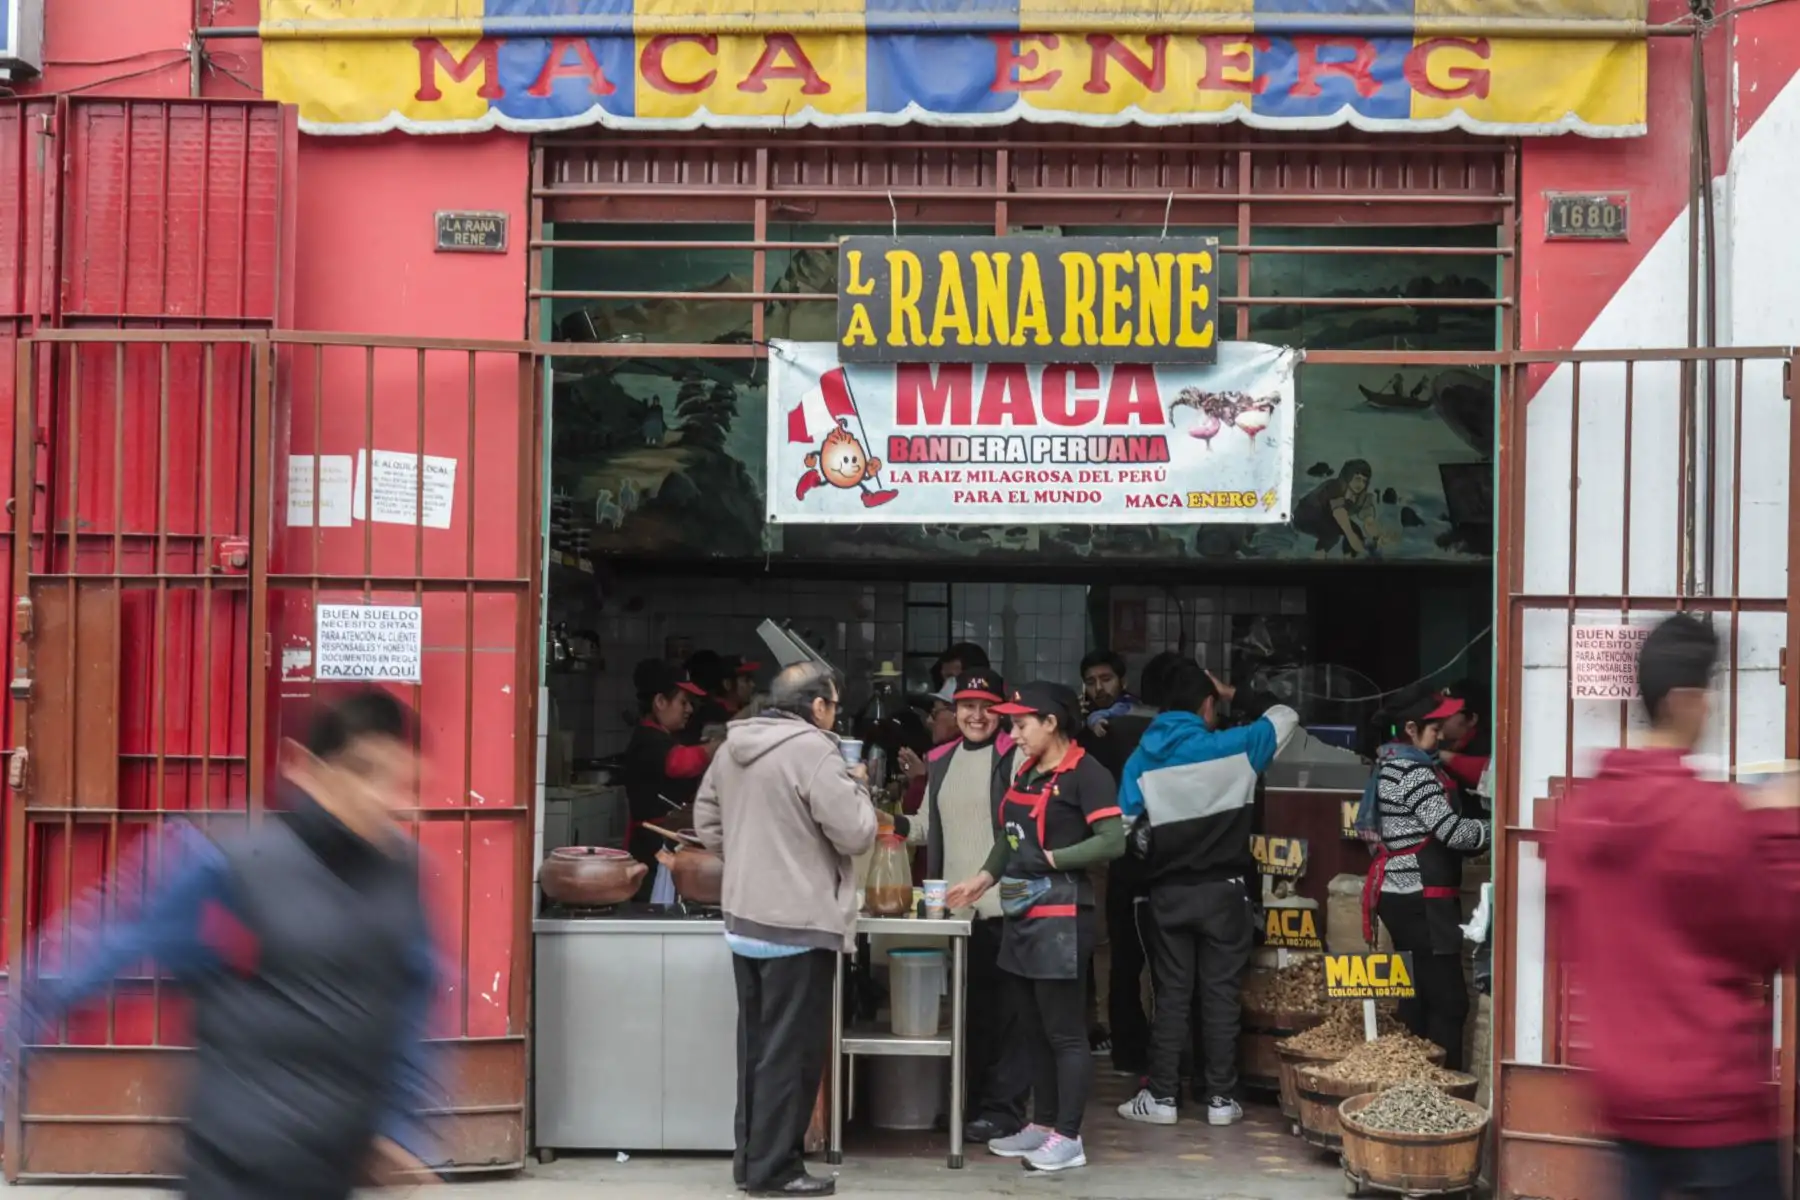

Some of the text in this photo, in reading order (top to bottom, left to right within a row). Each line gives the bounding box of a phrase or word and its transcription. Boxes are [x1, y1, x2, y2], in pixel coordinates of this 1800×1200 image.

[413, 32, 1491, 102] MACA ENERG
[1560, 205, 1616, 228] 1680
[446, 220, 496, 232] LA RANA
[455, 232, 486, 245] RENE
[885, 250, 1053, 346] RANA
[1059, 250, 1214, 347] RENE
[896, 363, 1166, 426] MACA
[888, 435, 1170, 463] BANDERA PERUANA
[424, 464, 448, 474] OCAL
[890, 466, 1167, 483] LA RAIZ MILAGROSA DEL PERÚ
[953, 490, 1102, 503] PARA EL MUNDO
[1125, 491, 1258, 508] MACA ENERG
[322, 609, 419, 620] BUEN SUELDO
[321, 620, 376, 629] NECESITO
[321, 631, 340, 641] PARA
[389, 632, 417, 642] CLIENTE
[1576, 629, 1650, 640] BUEN SUE
[322, 642, 375, 652] RESPONSABLES
[383, 643, 418, 653] HONESTAS
[1576, 640, 1632, 649] NECESITO
[322, 653, 376, 662] DOCUMENTOS
[379, 654, 389, 662] EN
[1576, 651, 1594, 661] PARA
[321, 664, 374, 676] RAZÓN
[1576, 662, 1632, 673] RESPONSABLES
[1577, 674, 1634, 684] DOCUMENTOS
[1576, 684, 1631, 697] RAZÓN
[1250, 836, 1303, 868] ACA
[1266, 909, 1317, 938] ACA
[1325, 954, 1411, 988] MACA
[1328, 987, 1373, 998] ECOLOGICA
